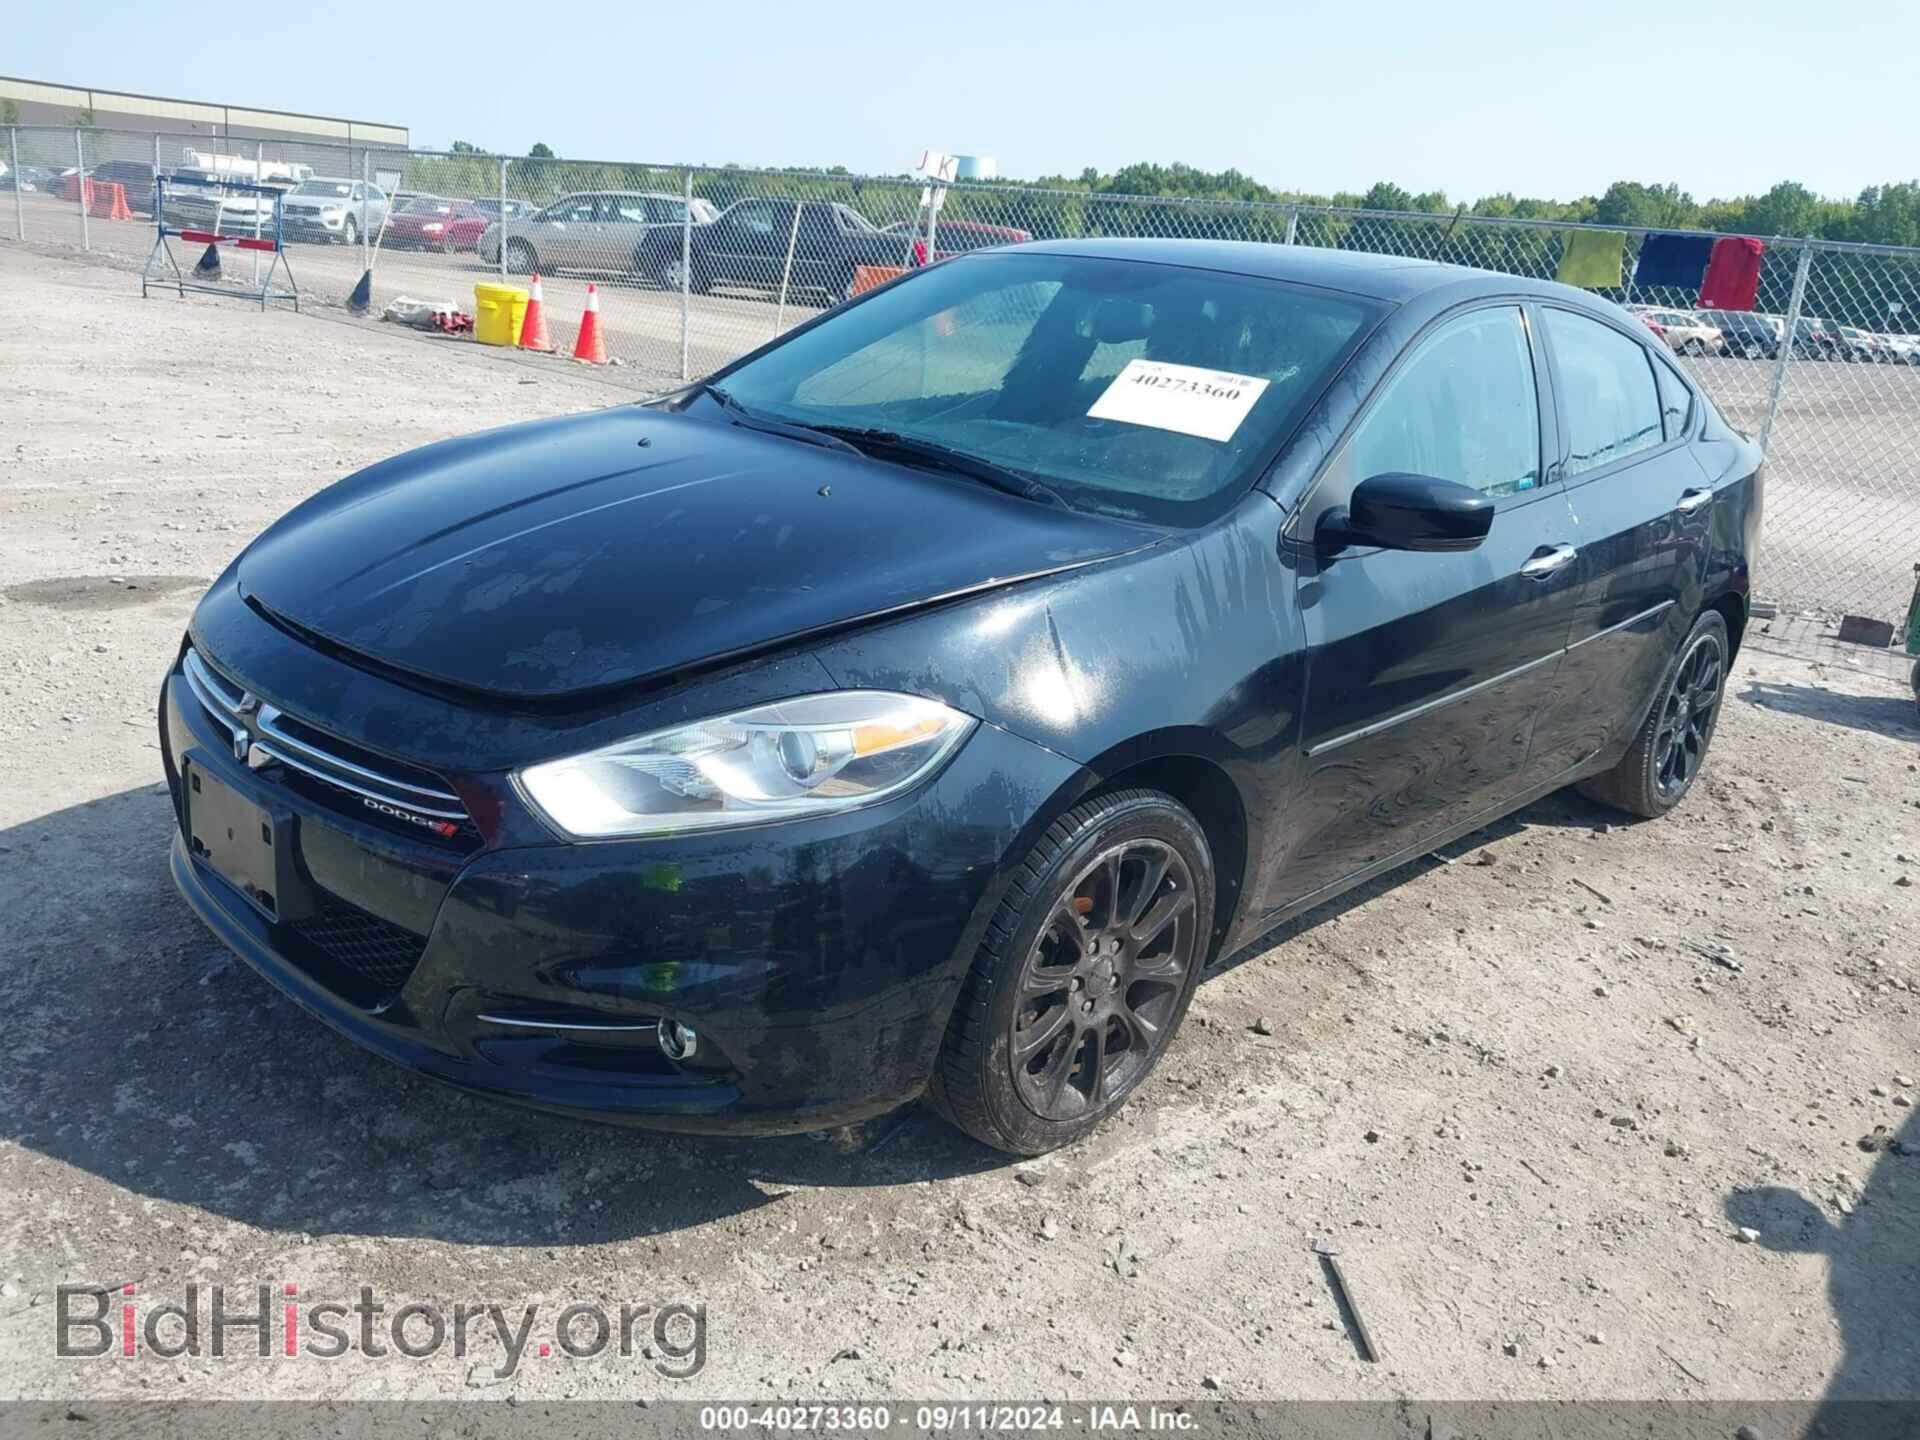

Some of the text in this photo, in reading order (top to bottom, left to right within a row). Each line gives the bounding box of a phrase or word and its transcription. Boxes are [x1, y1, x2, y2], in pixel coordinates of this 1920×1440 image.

[915, 149, 928, 170] J
[938, 155, 954, 180] K
[1131, 374, 1241, 400] 40273360
[363, 798, 442, 832] DODGE
